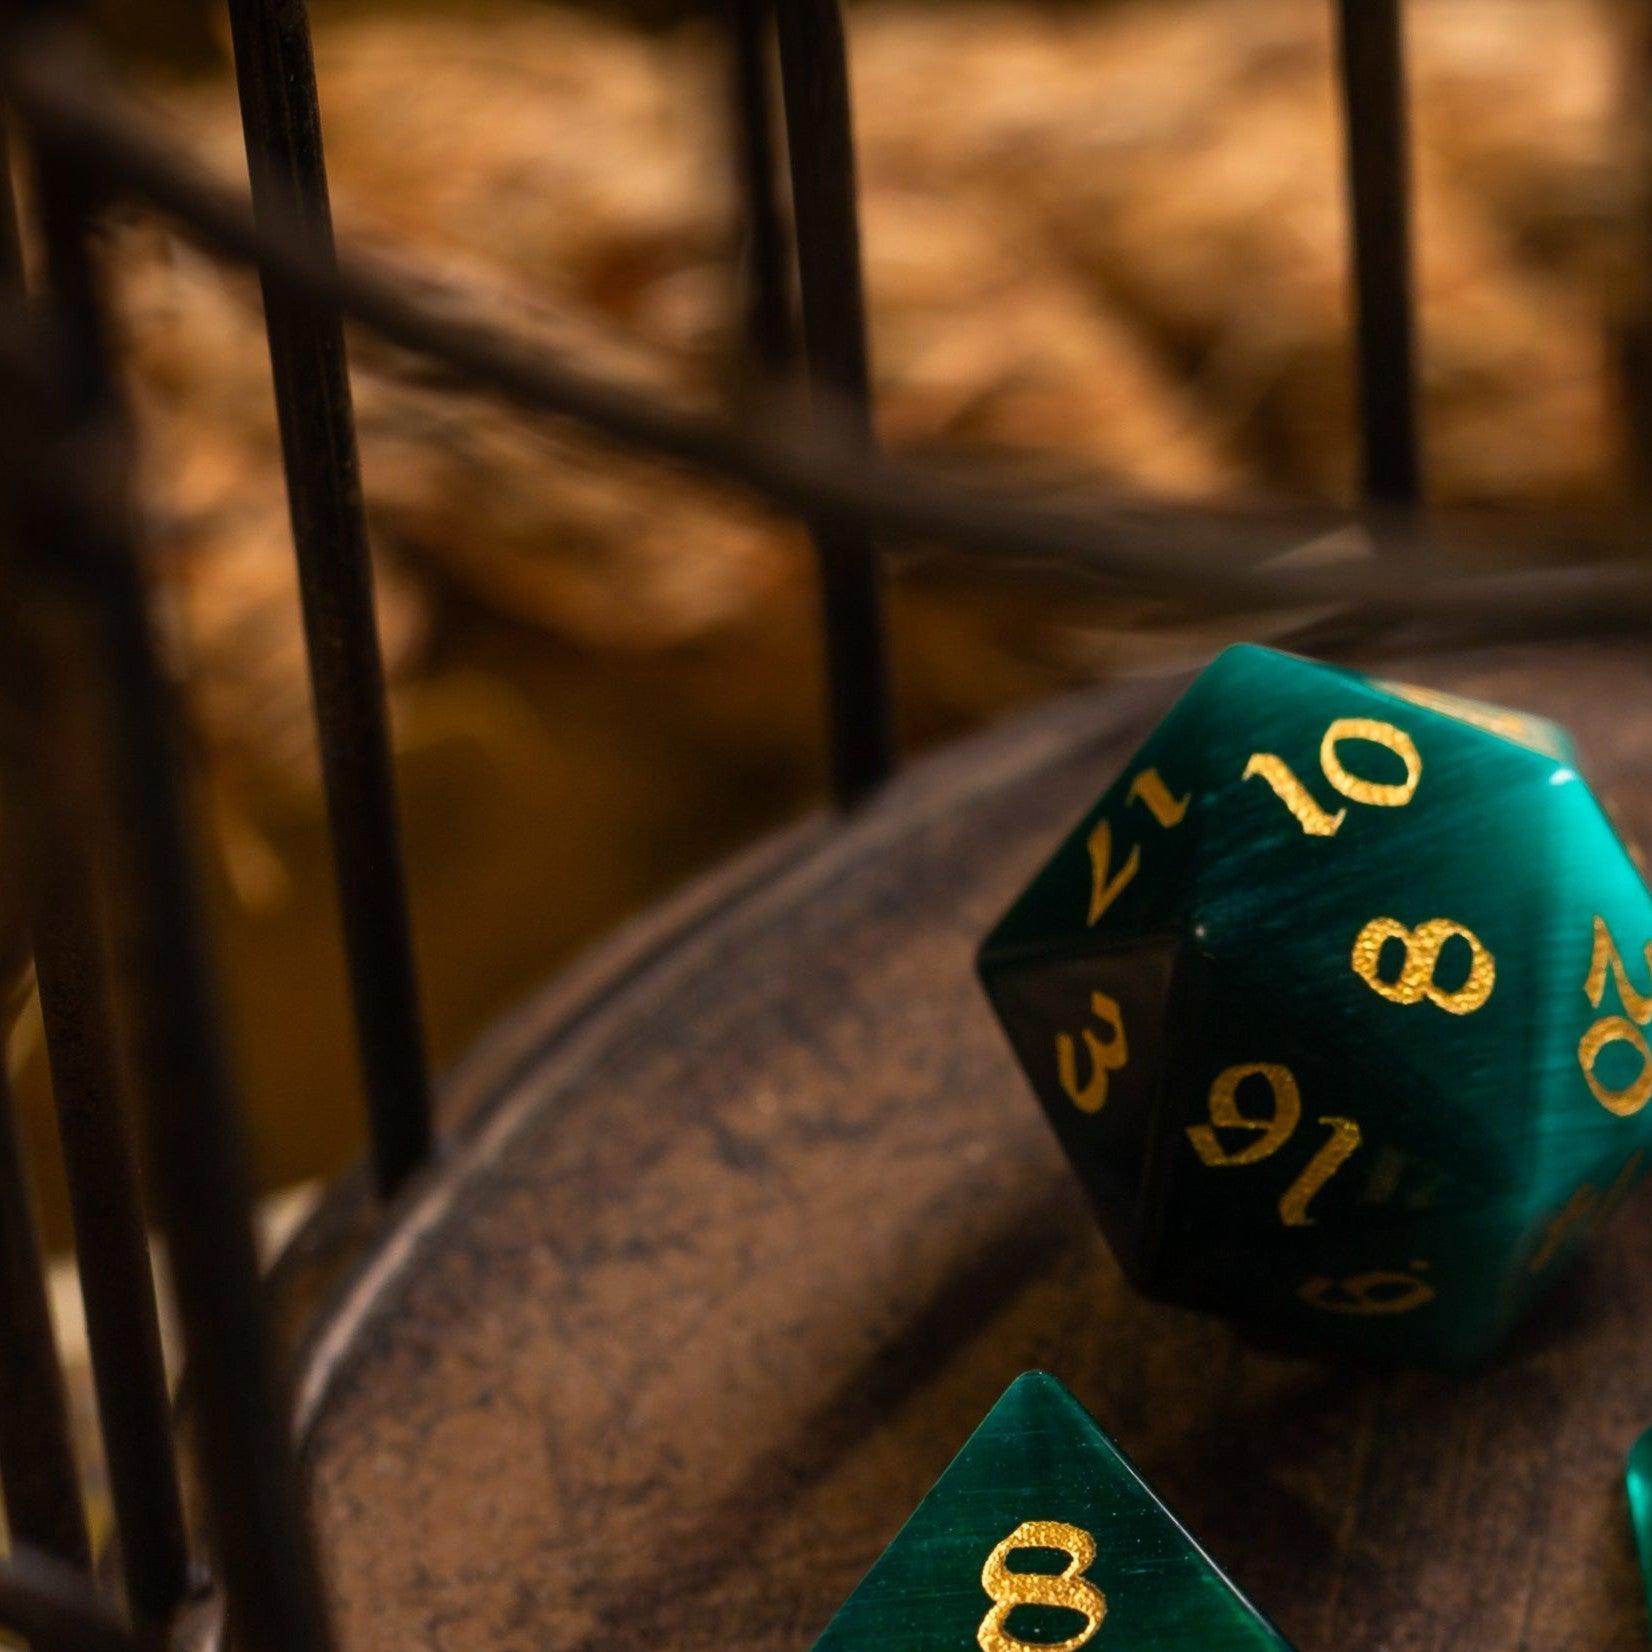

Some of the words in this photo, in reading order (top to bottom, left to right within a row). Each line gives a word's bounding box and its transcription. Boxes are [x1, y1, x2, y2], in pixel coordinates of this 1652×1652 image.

[1245, 720, 1420, 836] 10
[1088, 770, 1185, 923] 17
[1352, 918, 1495, 1014] 8
[1056, 992, 1129, 1113] 3
[1188, 1063, 1360, 1226] 16
